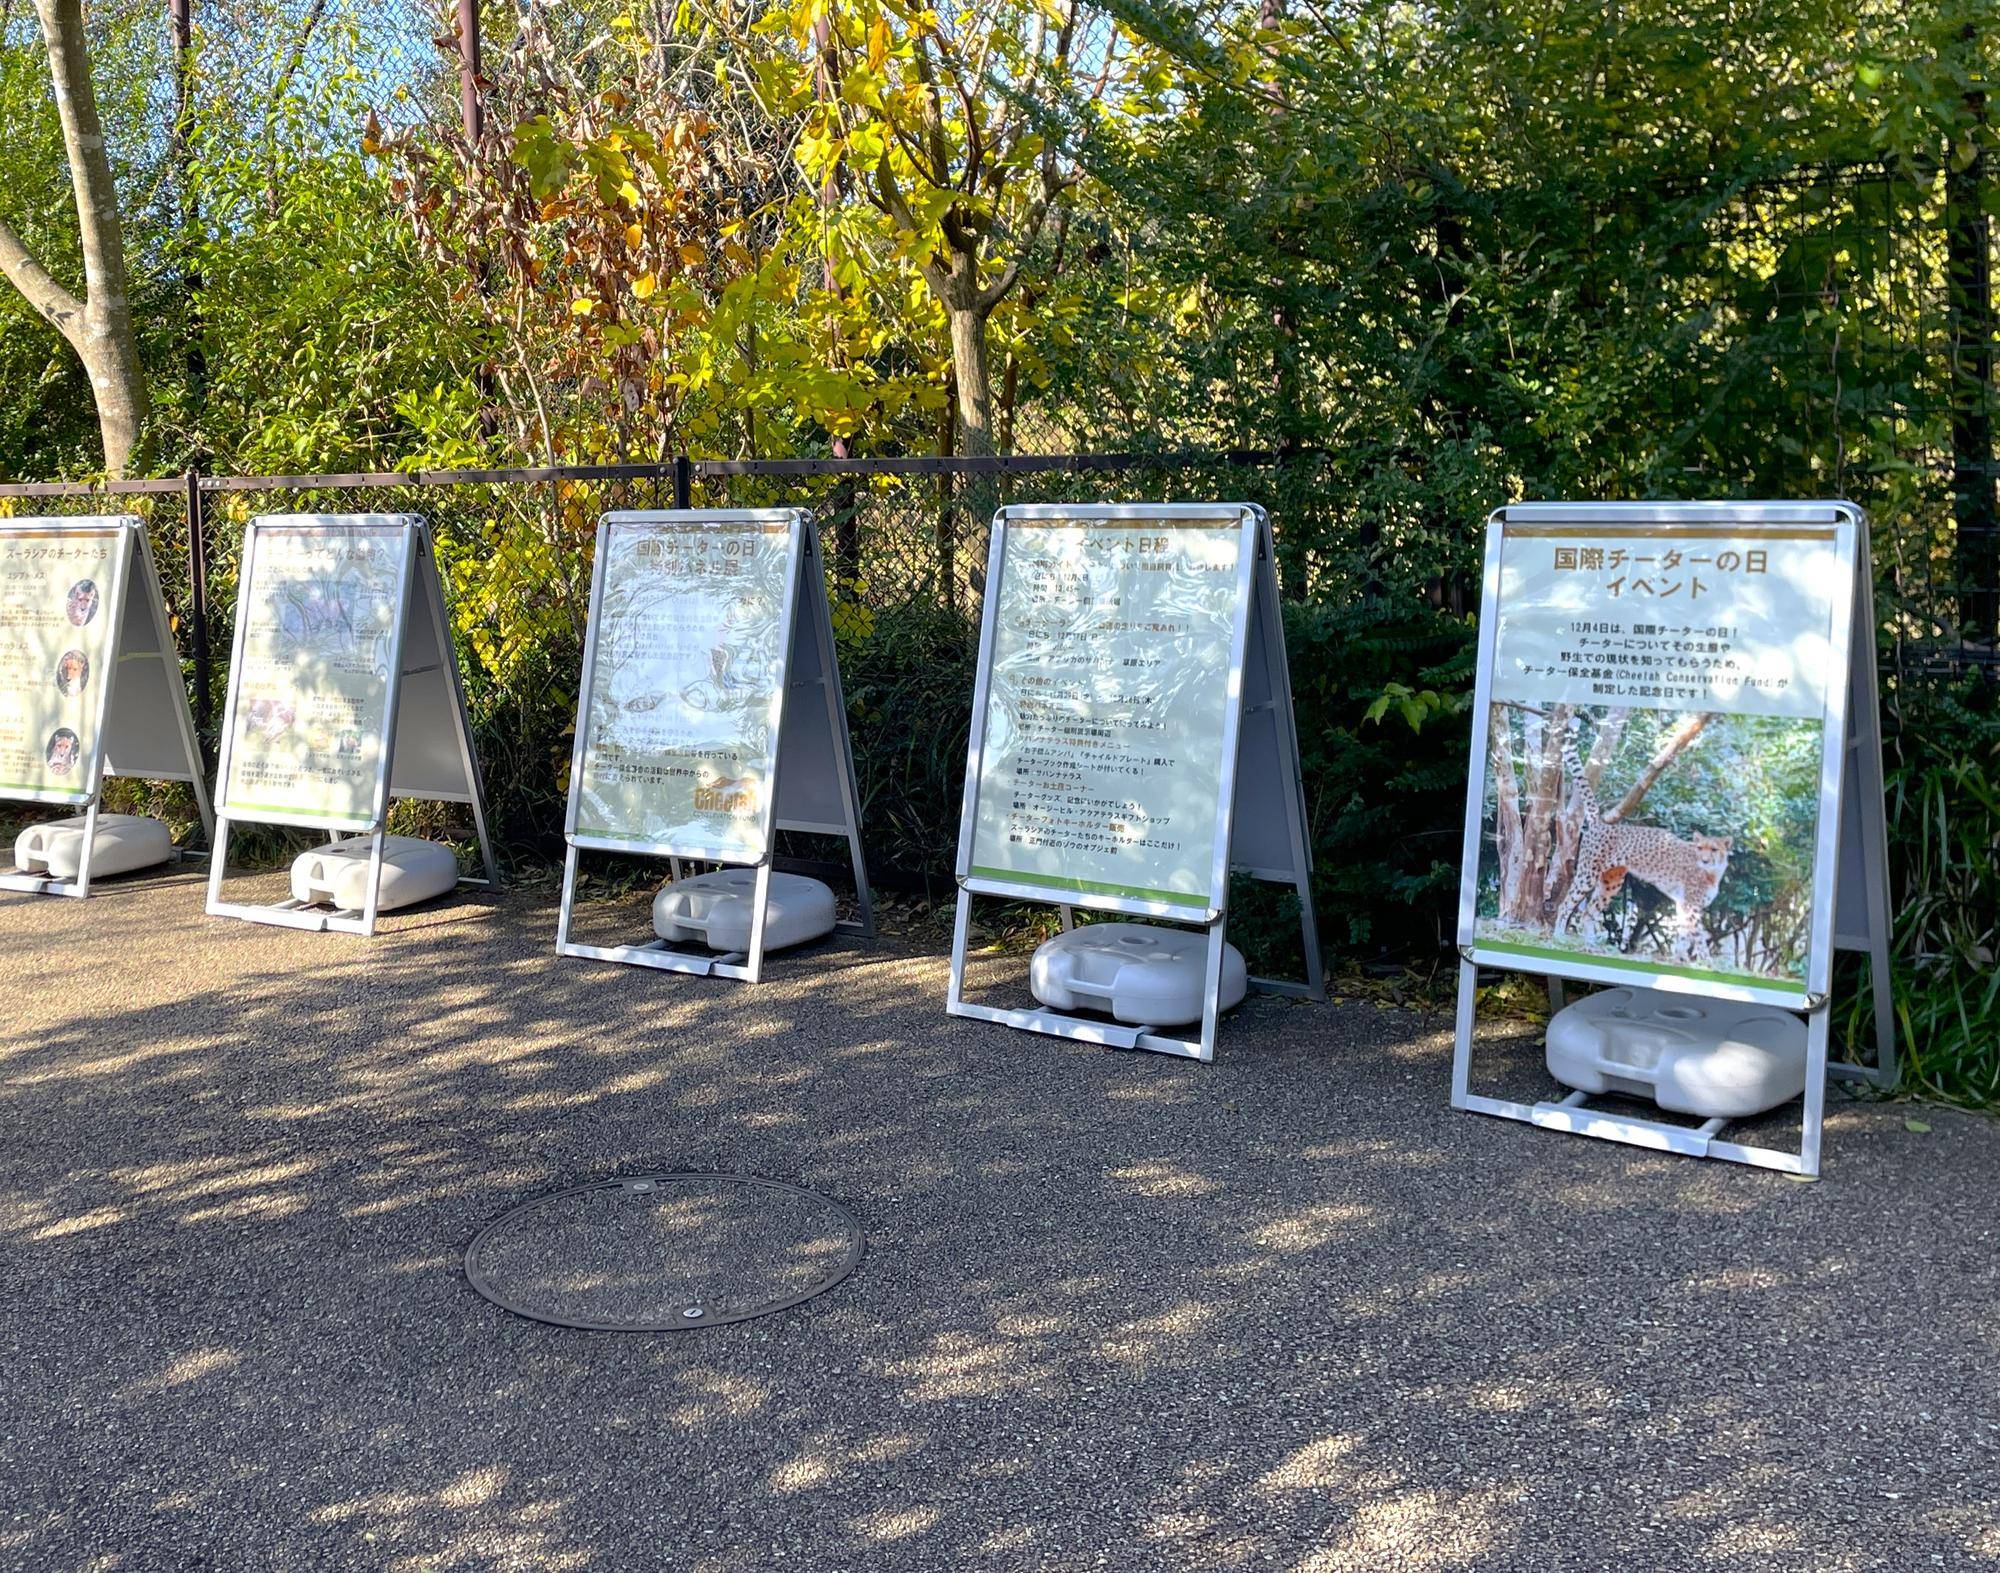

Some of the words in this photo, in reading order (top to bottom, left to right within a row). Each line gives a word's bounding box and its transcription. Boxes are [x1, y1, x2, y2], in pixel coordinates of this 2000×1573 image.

[1553, 547, 1768, 574] 国際チーターの日
[1606, 575, 1708, 600] イベント
[1570, 622, 1739, 639] 12月4日は、国際チーターの日！
[1579, 637, 1732, 654] チーターについてその生態や
[1560, 651, 1742, 671] 野生での現状を知ってもらうため、
[1592, 682, 1708, 700] 制定した記念日です！
